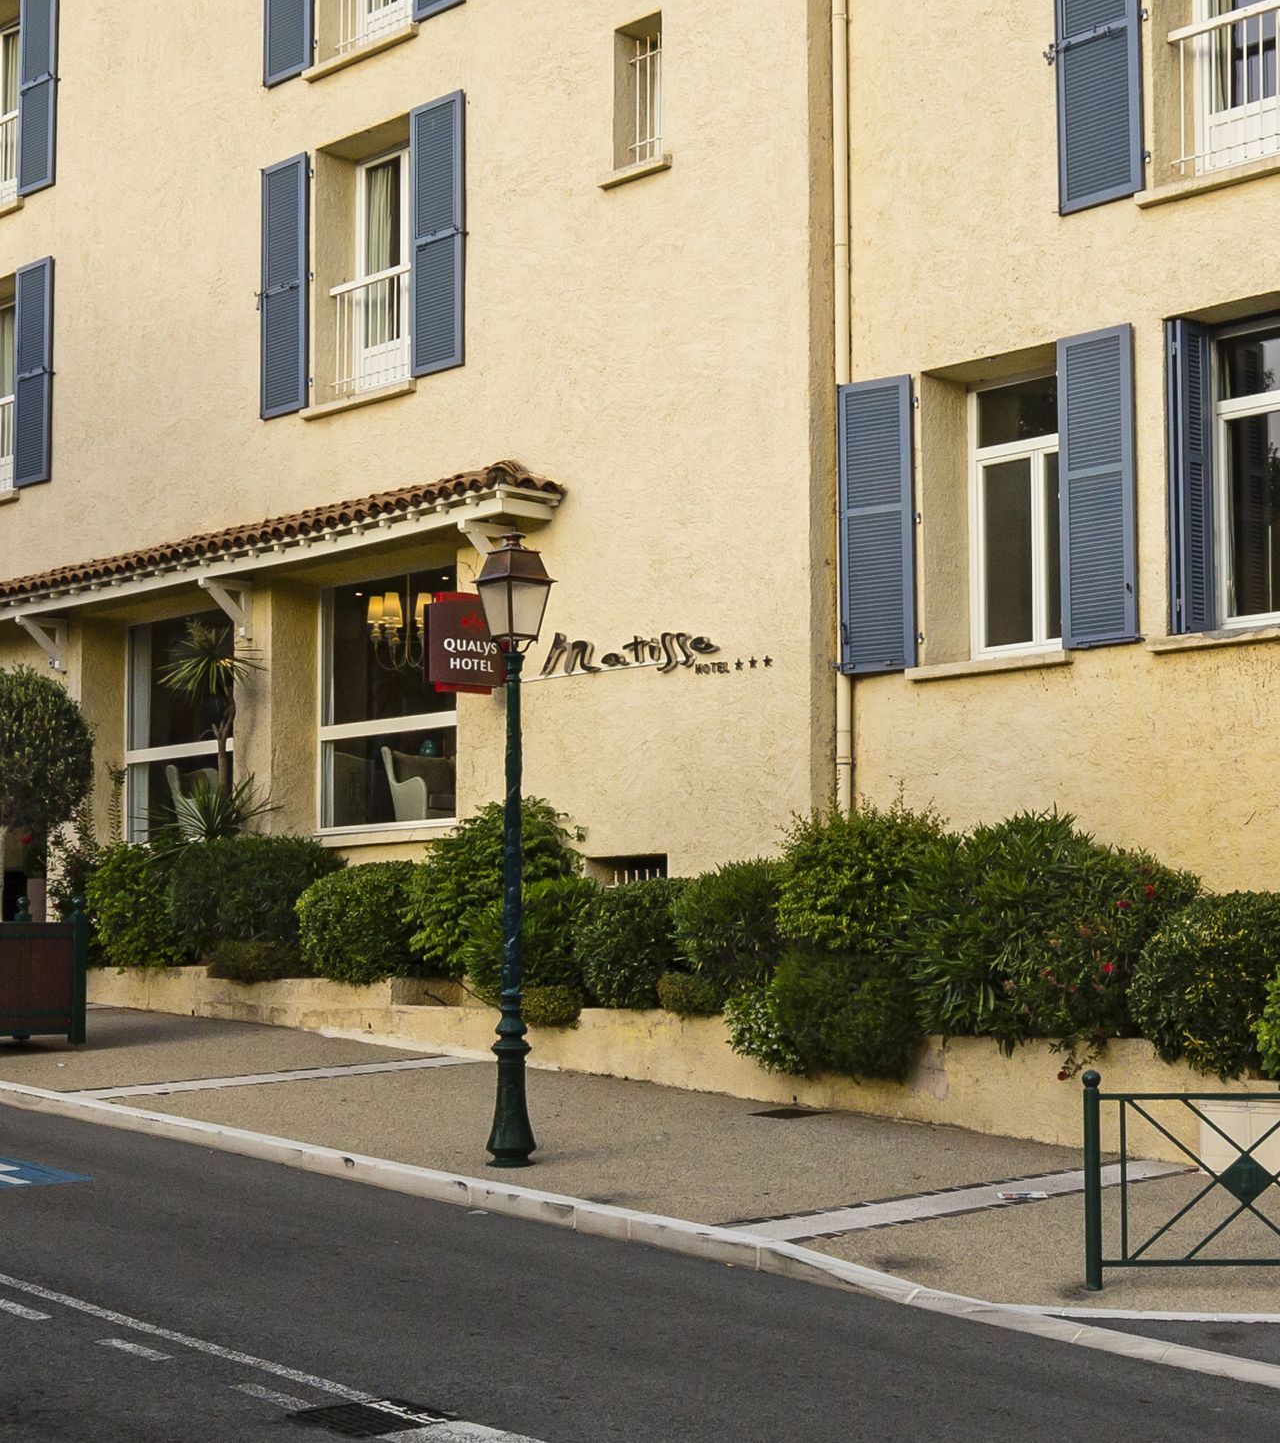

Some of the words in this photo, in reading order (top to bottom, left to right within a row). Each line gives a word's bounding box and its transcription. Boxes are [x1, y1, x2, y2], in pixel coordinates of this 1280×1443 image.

[540, 632, 721, 675] Matisse
[449, 657, 494, 673] HOTEL
[695, 661, 730, 675] HOTEL
